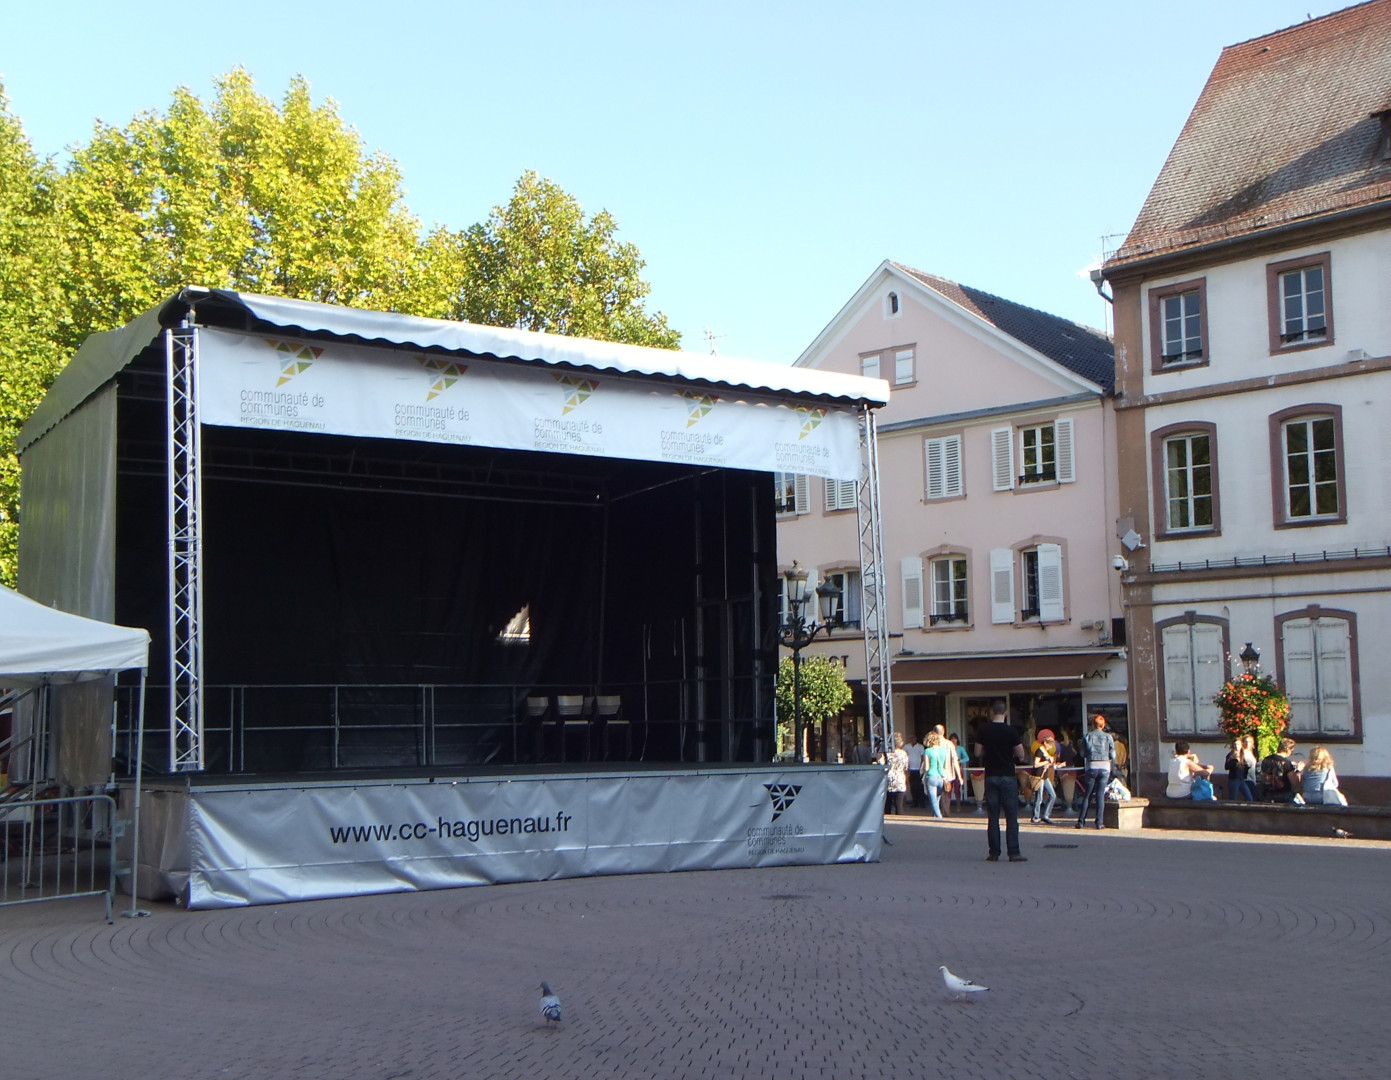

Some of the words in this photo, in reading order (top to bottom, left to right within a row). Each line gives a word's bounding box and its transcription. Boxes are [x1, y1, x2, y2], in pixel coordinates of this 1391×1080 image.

[240, 389, 308, 406] communauté
[312, 393, 324, 407] de
[240, 401, 299, 417] communes
[394, 403, 455, 420] communauté
[458, 408, 470, 421] de
[394, 415, 446, 430] communes
[534, 417, 589, 433] communauté
[591, 422, 603, 434] de
[534, 427, 581, 443] communes
[330, 811, 572, 844] www.cc-haguenau.fr
[747, 825, 792, 837] communauté
[794, 824, 803, 835] de
[747, 836, 786, 847] communes
